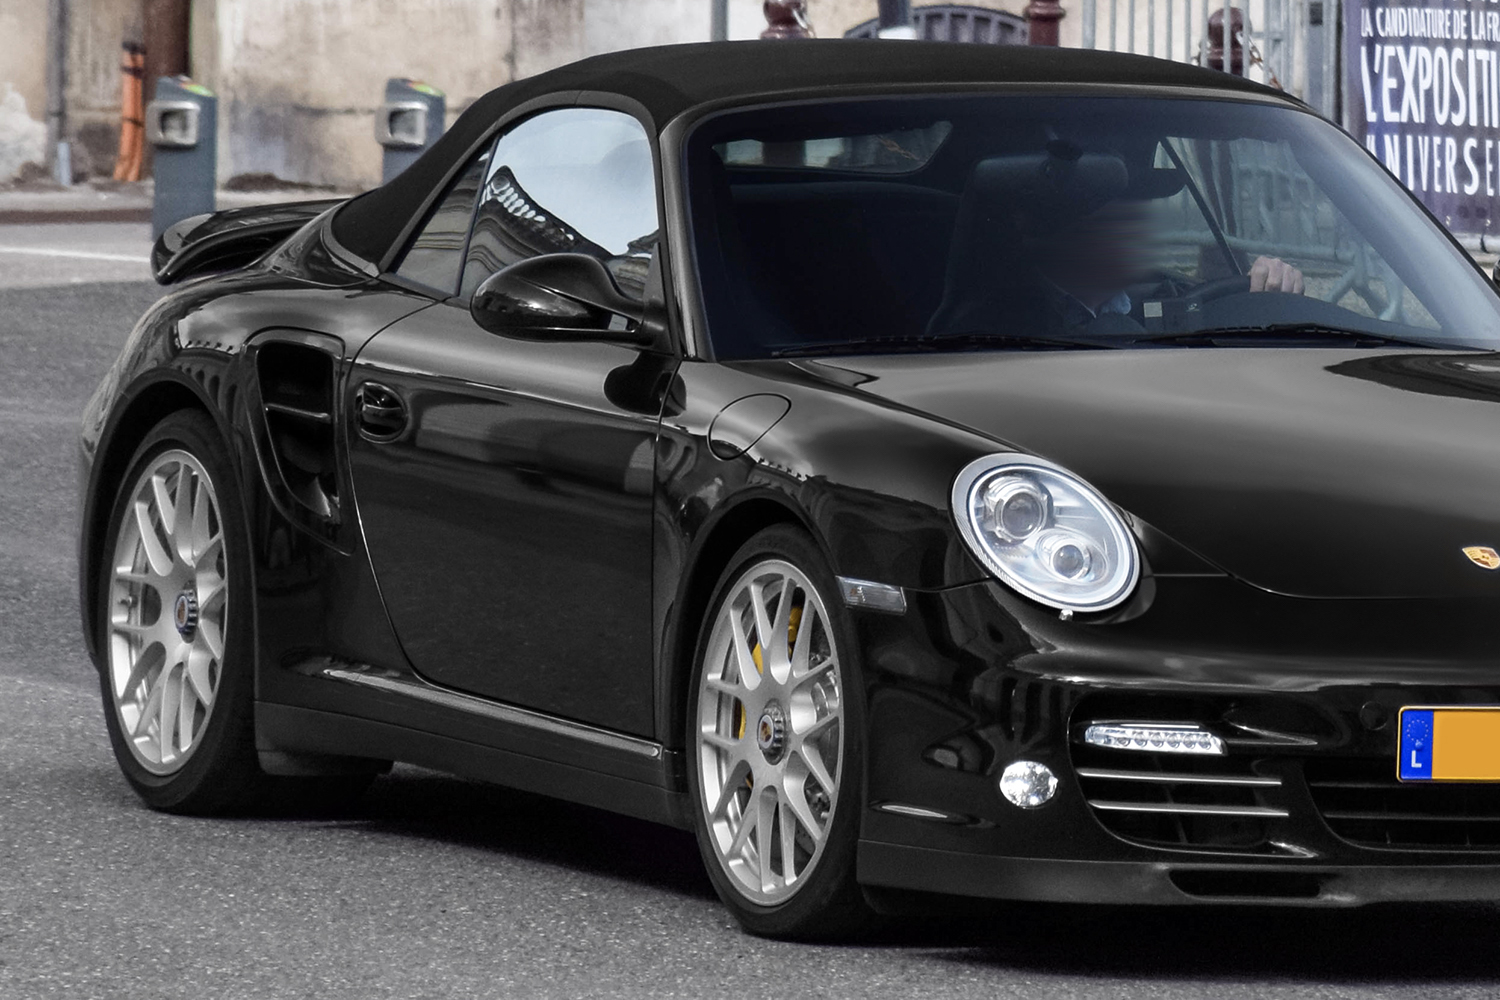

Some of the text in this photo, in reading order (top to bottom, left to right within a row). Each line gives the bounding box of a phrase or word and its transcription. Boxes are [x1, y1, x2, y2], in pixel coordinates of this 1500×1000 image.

[1376, 7, 1451, 38] CANDIDATURE
[1453, 9, 1467, 40] DE
[1471, 10, 1487, 41] LA
[1411, 750, 1422, 768] L
